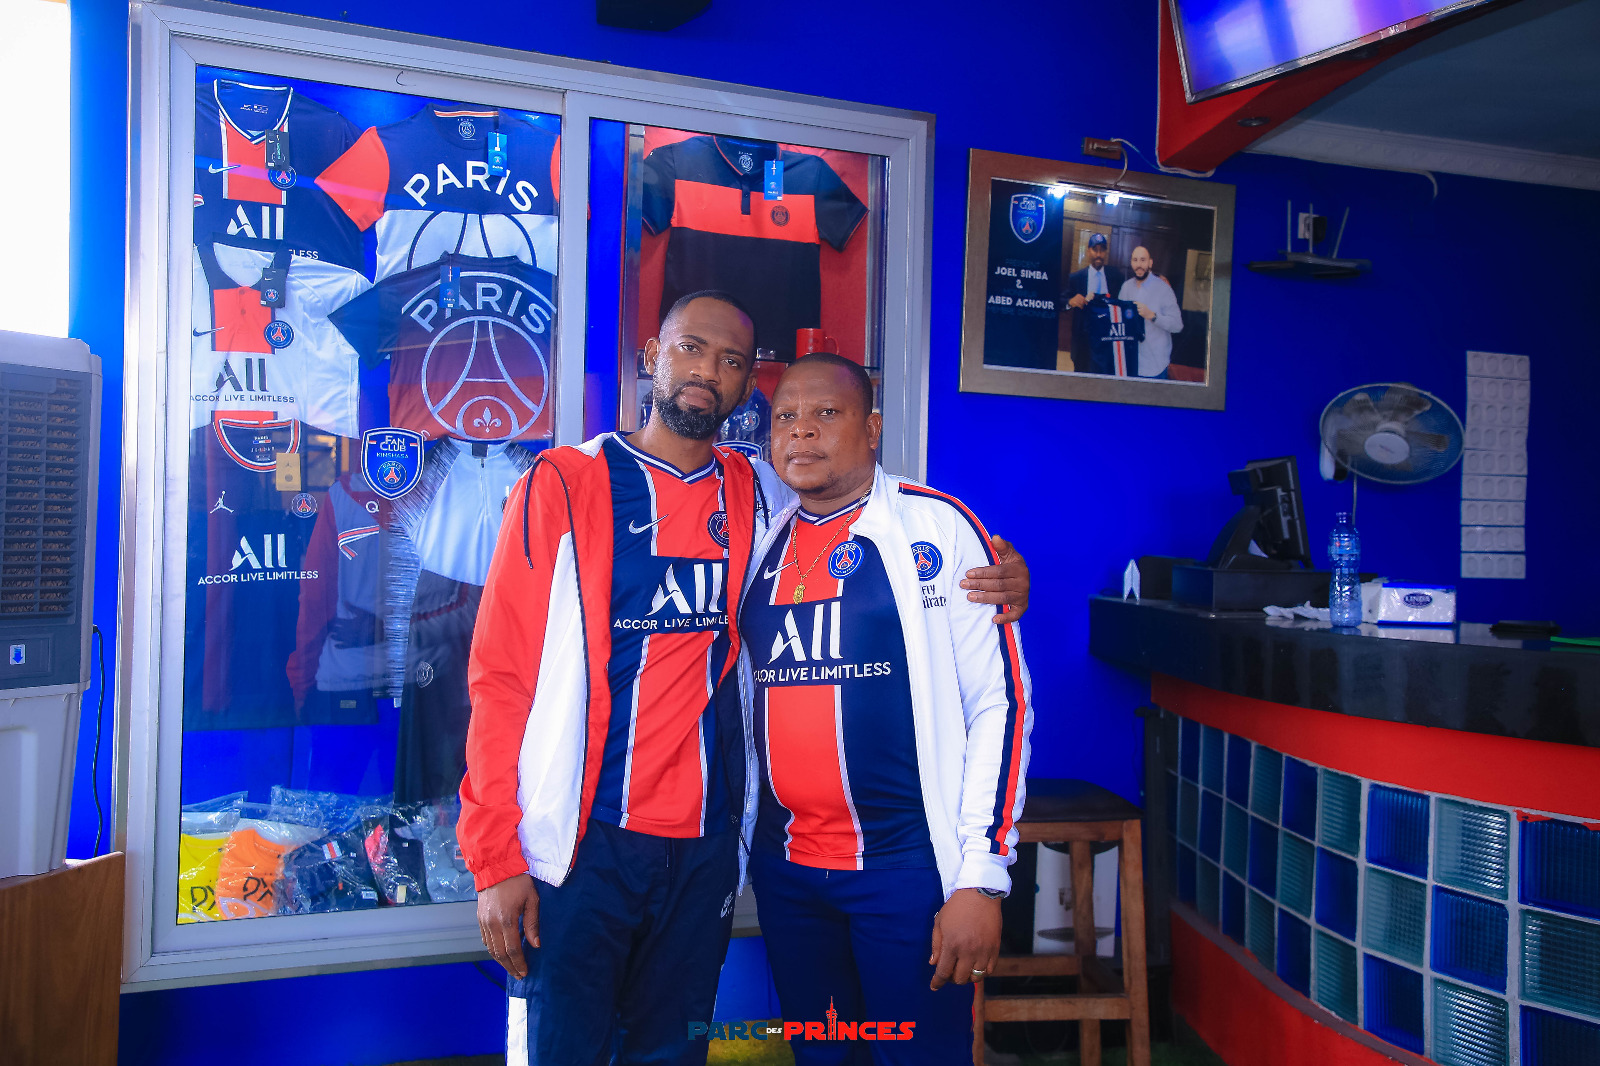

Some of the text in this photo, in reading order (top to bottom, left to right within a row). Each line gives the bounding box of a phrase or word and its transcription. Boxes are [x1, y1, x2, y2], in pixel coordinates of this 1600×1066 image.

[403, 160, 539, 212] PARIS
[995, 266, 1048, 280] JOEL SIMBA
[988, 295, 1054, 310] ABED ACHOUR
[224, 394, 245, 402] LIVE
[249, 394, 295, 404] LIMITLESS
[380, 441, 406, 452] CLUB
[385, 435, 405, 444] FAN
[197, 570, 319, 585] ACCOR LIVE LIMITLESS
[613, 618, 658, 630] ACCOR
[664, 618, 692, 628] LIVE
[778, 666, 809, 682] LIVE
[812, 661, 892, 680] LIMITLESS
